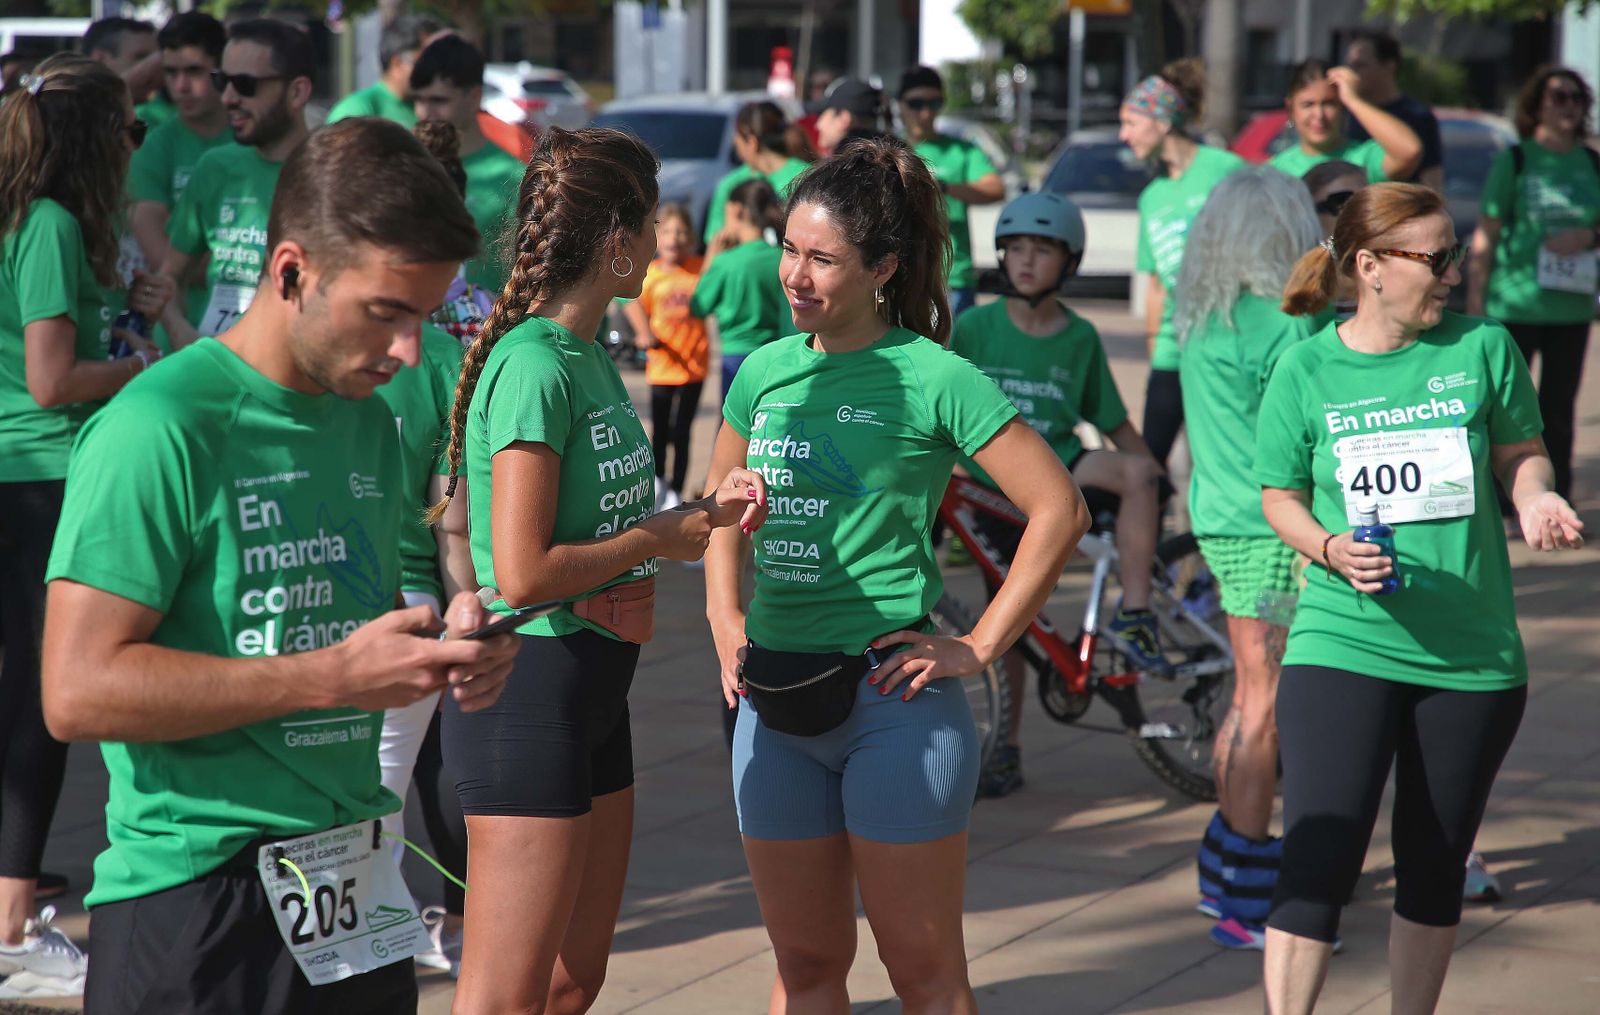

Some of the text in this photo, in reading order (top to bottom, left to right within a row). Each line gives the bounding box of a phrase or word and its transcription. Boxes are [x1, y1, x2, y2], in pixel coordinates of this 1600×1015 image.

[1326, 397, 1467, 434] En marcha
[590, 422, 621, 451] En
[747, 435, 811, 459] archa
[598, 442, 650, 482] marcha
[1350, 461, 1422, 497] 400
[599, 476, 650, 512] contra
[766, 490, 830, 518] áncer
[237, 494, 282, 532] En
[243, 528, 347, 574] marcha
[790, 569, 821, 583] Motor
[240, 575, 333, 616] contra
[235, 619, 279, 656] el
[283, 730, 349, 748] Grazalema
[304, 850, 316, 863] el
[316, 844, 349, 860] cáncer
[281, 877, 358, 945] 205
